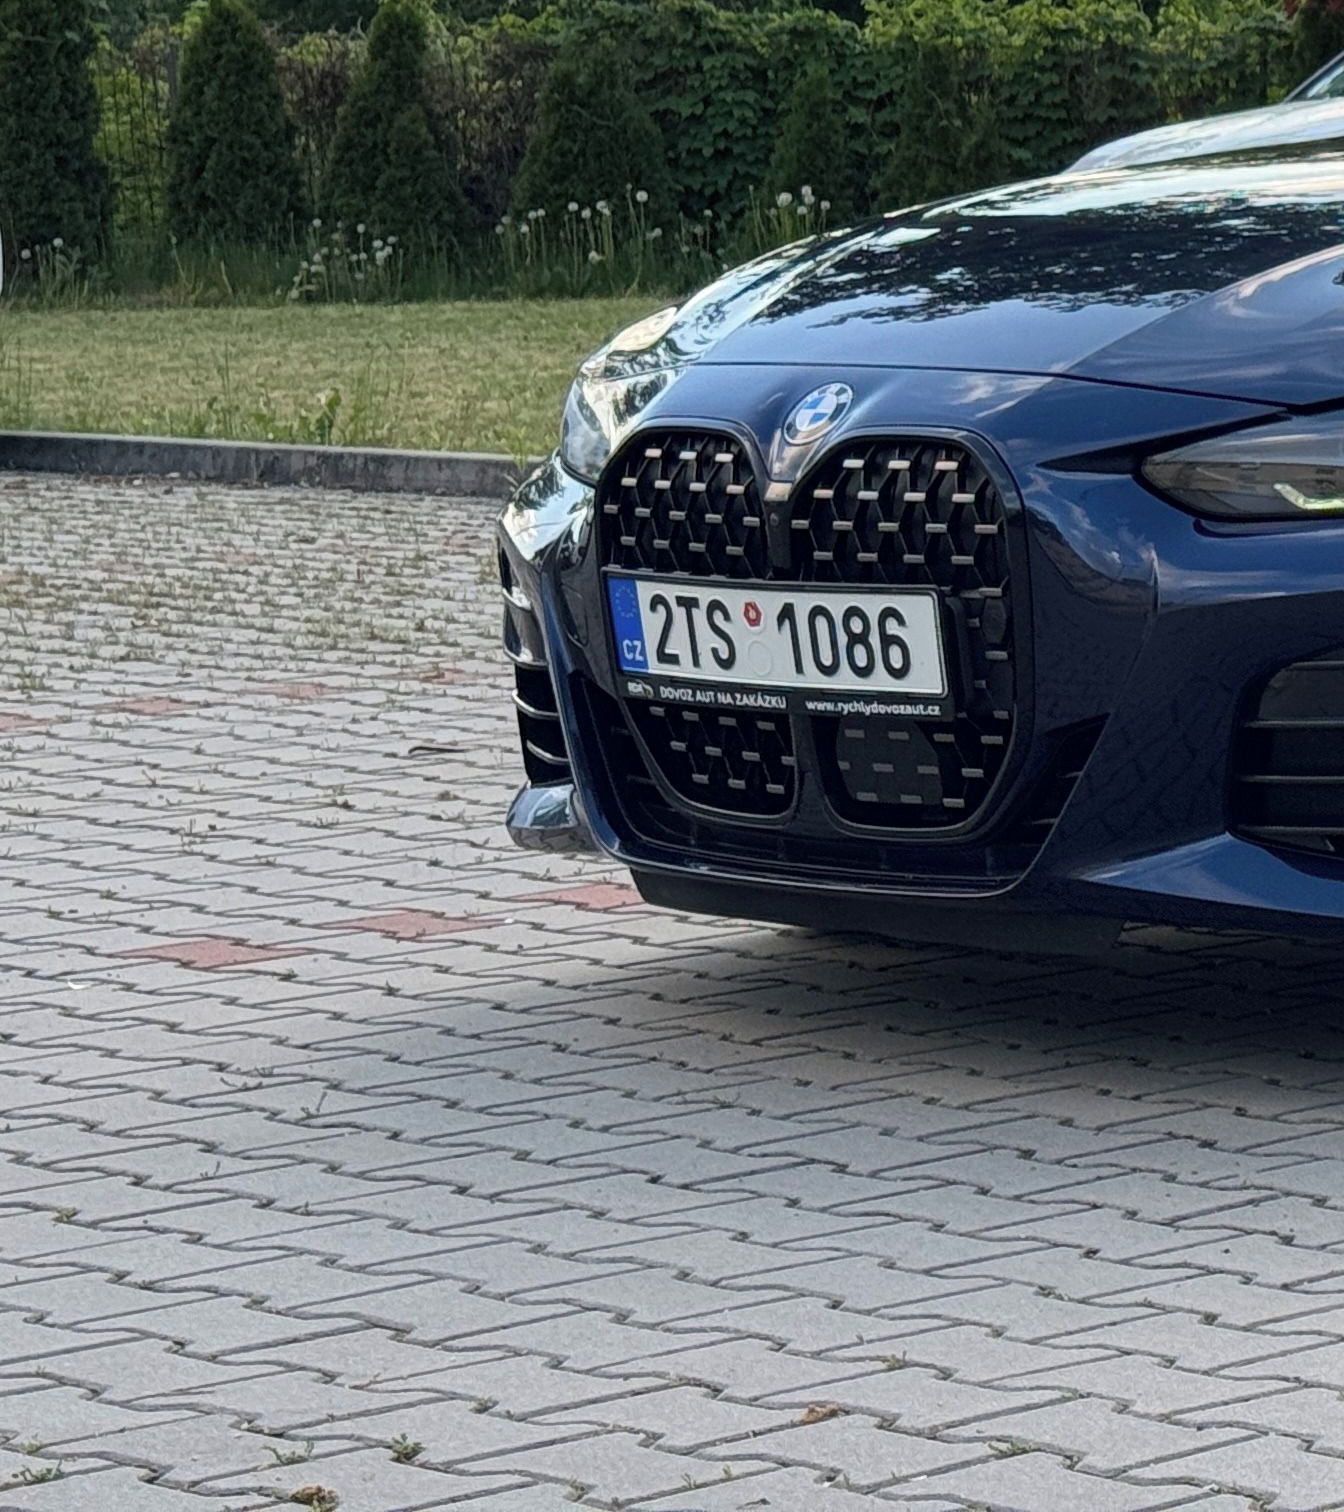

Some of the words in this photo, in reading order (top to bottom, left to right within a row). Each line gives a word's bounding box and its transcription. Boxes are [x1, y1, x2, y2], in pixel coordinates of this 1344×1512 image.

[649, 593, 736, 671] 2TS
[776, 602, 911, 680] 1086
[622, 639, 644, 662] CZ
[659, 685, 694, 702] DOVOZ
[696, 691, 716, 704] AUT
[717, 693, 734, 706] NA
[735, 692, 787, 709] ZAKÁZKU
[805, 700, 941, 716] www.rychlydovozaut.cz
